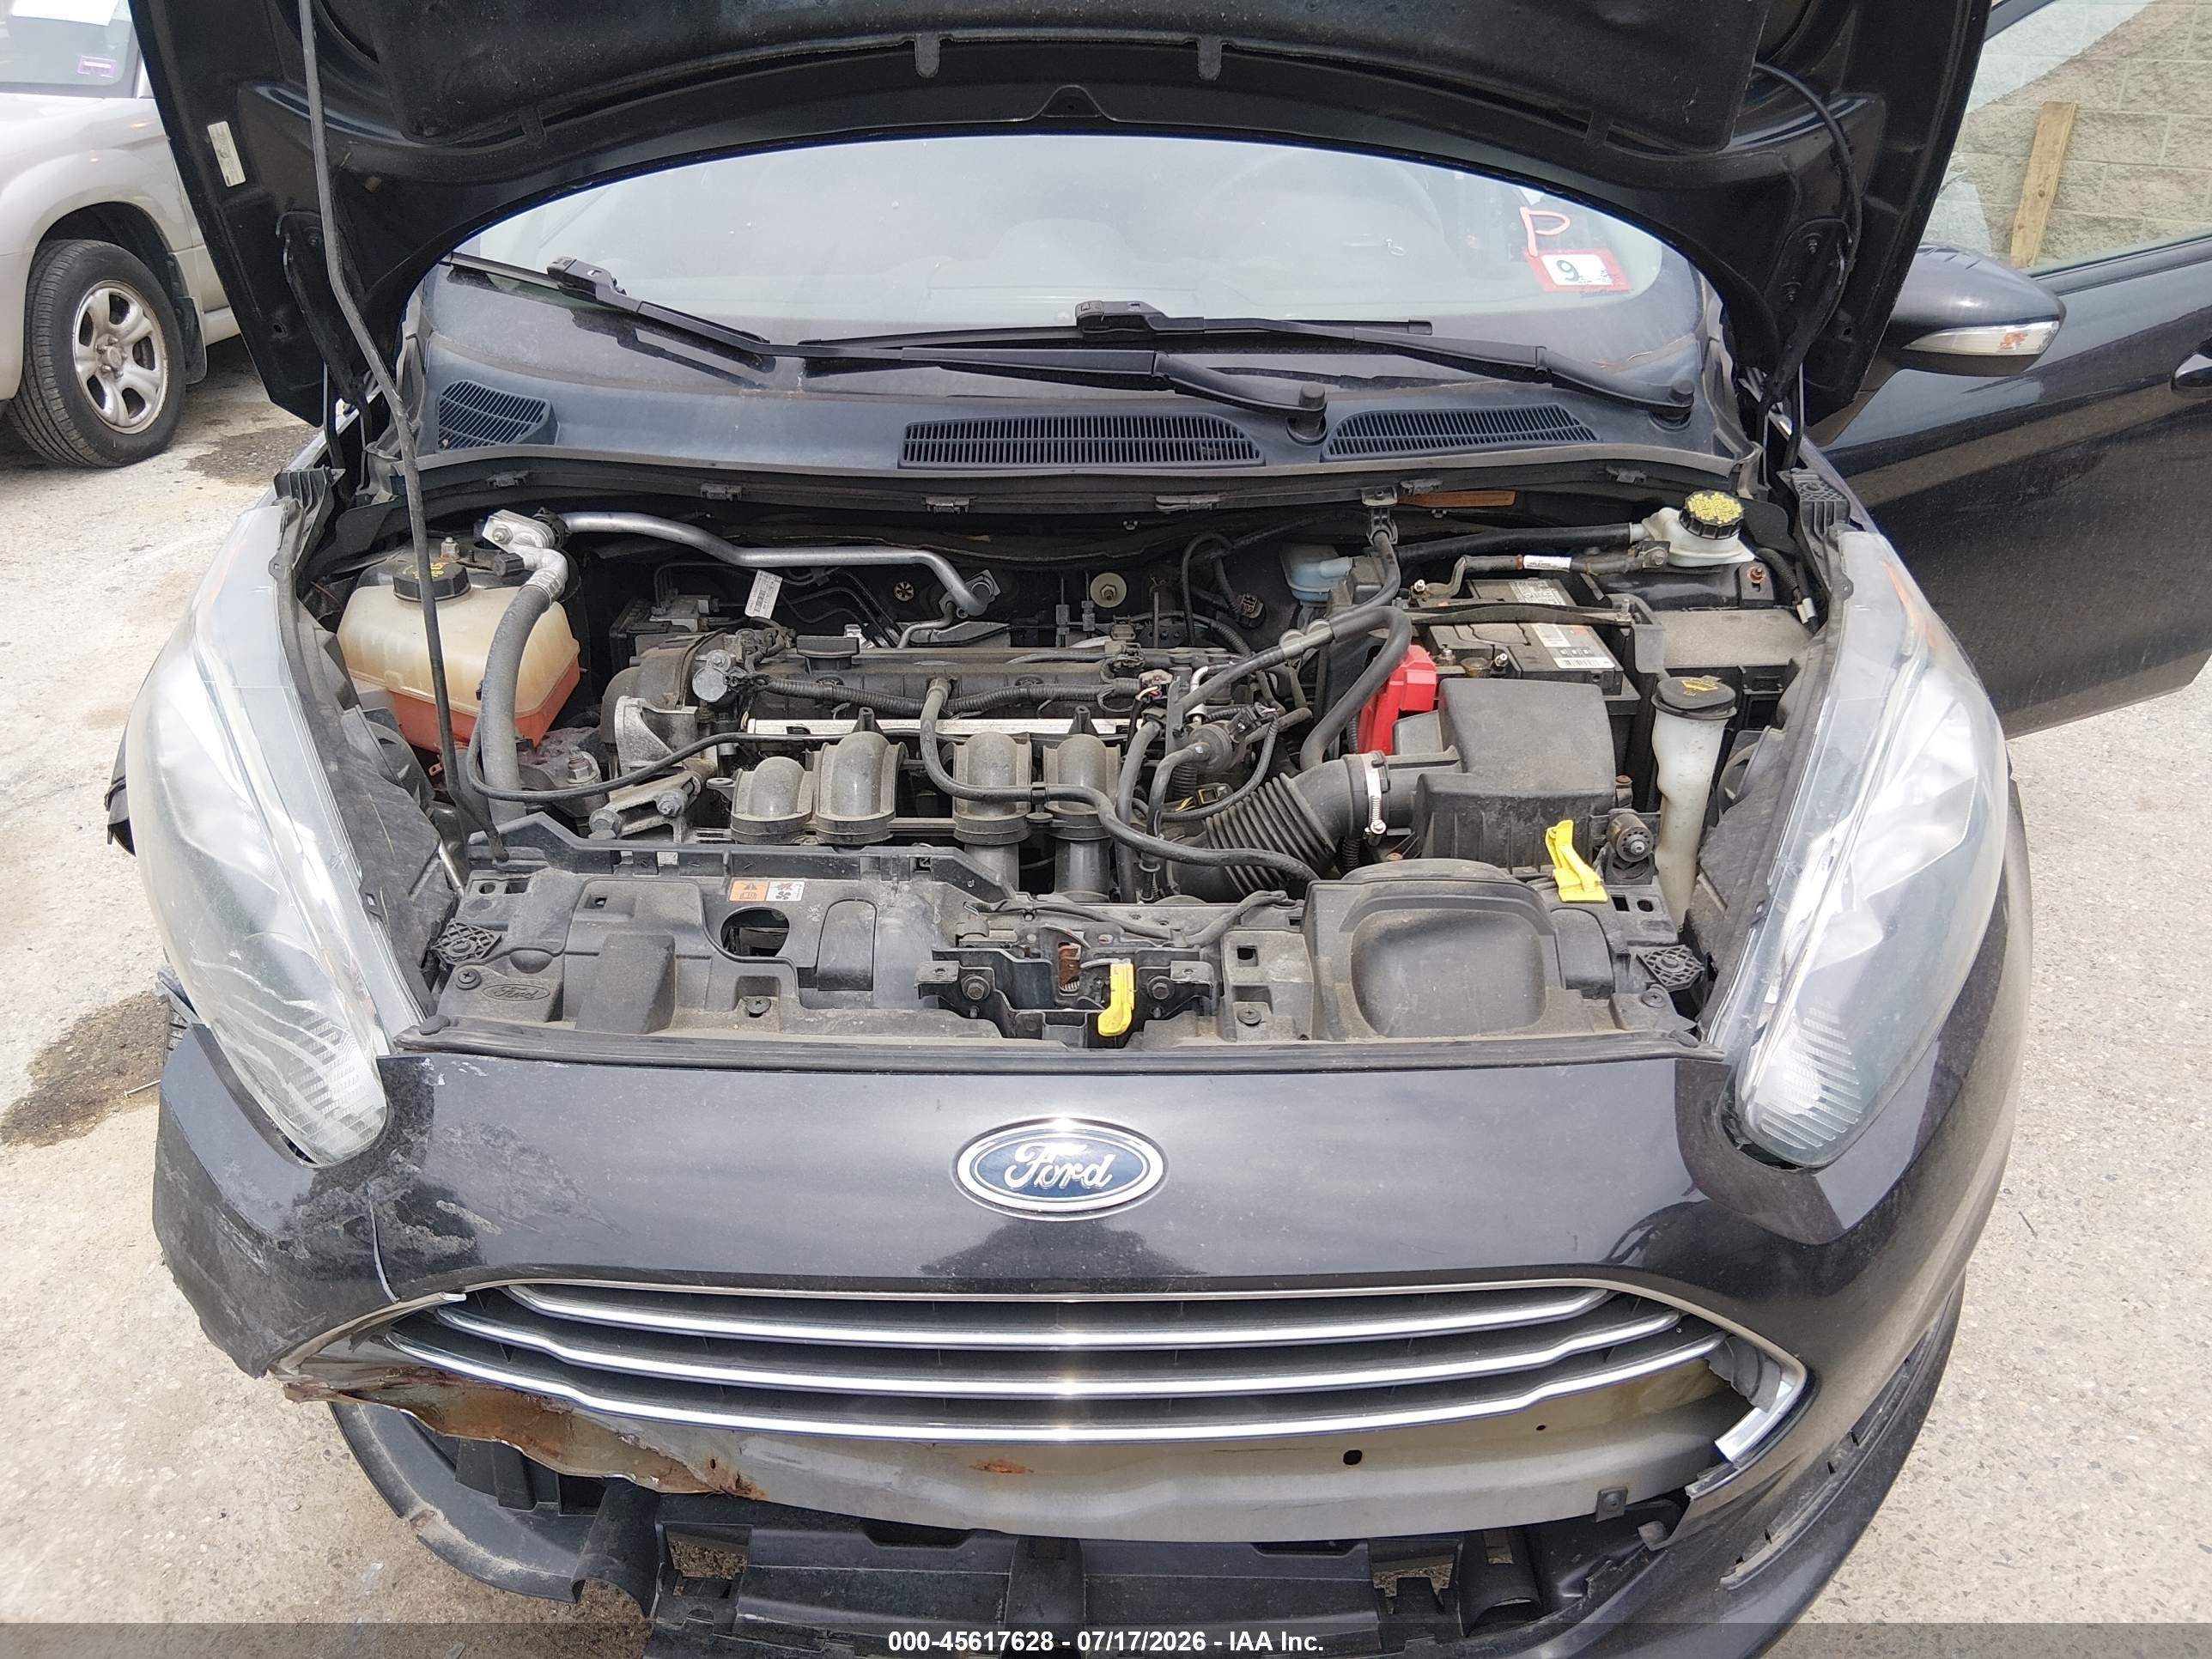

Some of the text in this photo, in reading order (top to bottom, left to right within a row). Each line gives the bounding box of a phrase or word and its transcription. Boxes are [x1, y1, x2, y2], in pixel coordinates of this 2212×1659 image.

[1519, 206, 1571, 257] P
[1556, 259, 1580, 283] 9
[494, 986, 539, 1000] Ford
[1004, 1140, 1116, 1190] Ford
